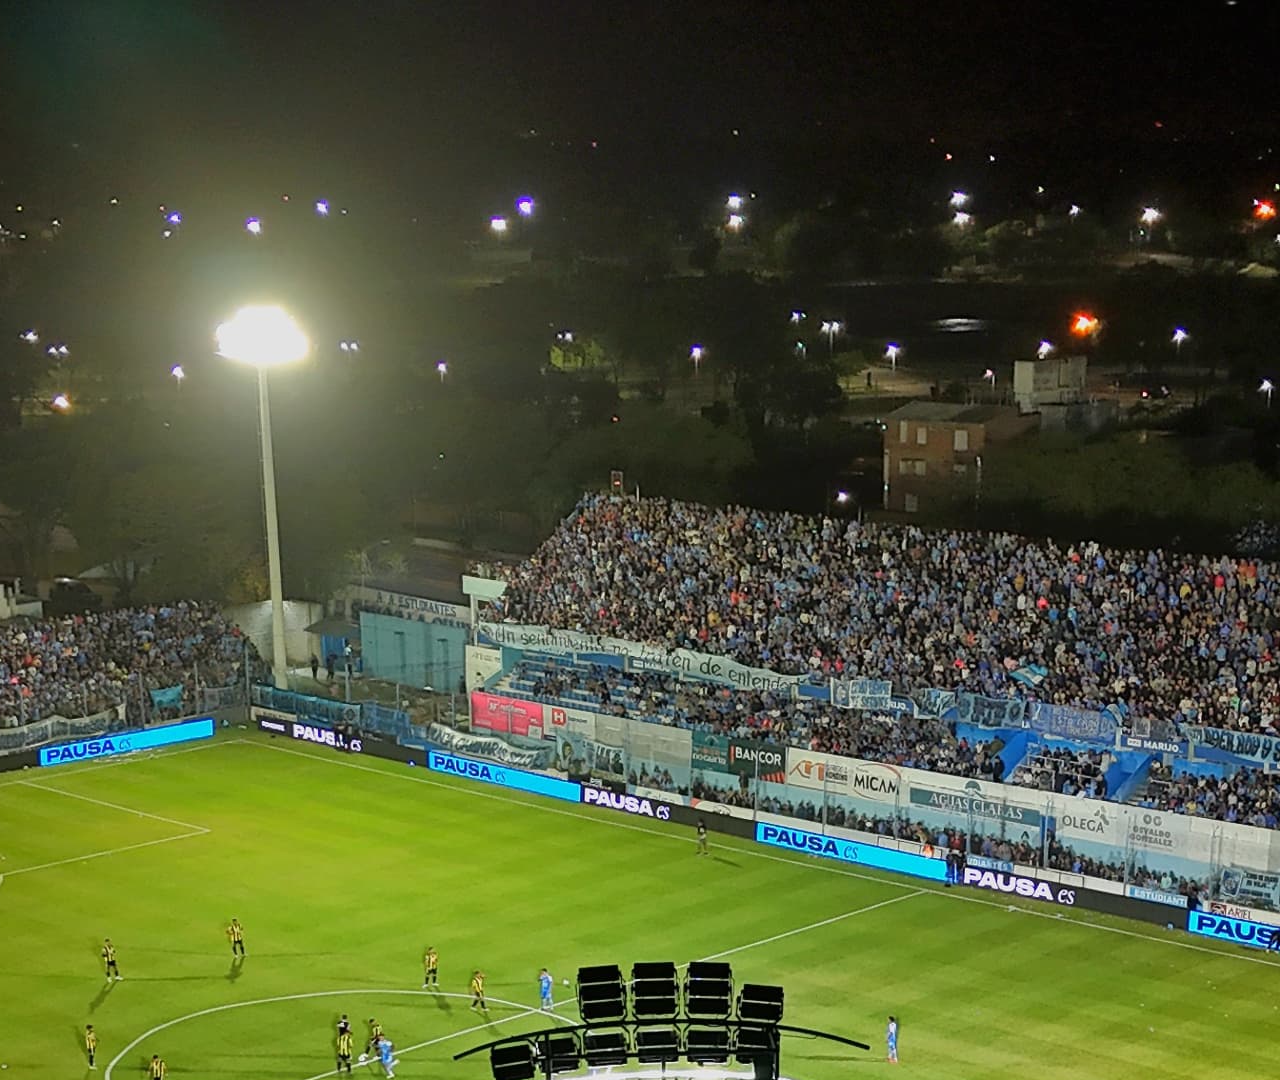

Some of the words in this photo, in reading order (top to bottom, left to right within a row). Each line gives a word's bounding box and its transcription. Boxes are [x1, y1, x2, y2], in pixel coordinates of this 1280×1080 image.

[398, 595, 457, 617] ESTUDIANTES
[700, 657, 722, 677] de
[47, 740, 116, 763] PAUSA
[735, 746, 781, 766] BANCOR
[1143, 741, 1180, 752] MARIJO
[434, 755, 492, 781] PAUSA
[854, 774, 899, 796] MICAM
[584, 787, 655, 817] PAUSA
[656, 805, 670, 821] es
[929, 792, 969, 811] AGUAS
[1061, 815, 1105, 834] OLEGA
[1132, 825, 1172, 840] OSVALDO
[763, 825, 840, 857] PAUSA
[843, 841, 860, 861] es
[963, 868, 1054, 901] PAUSA
[1056, 884, 1076, 906] es
[1228, 907, 1252, 921] ARIEL
